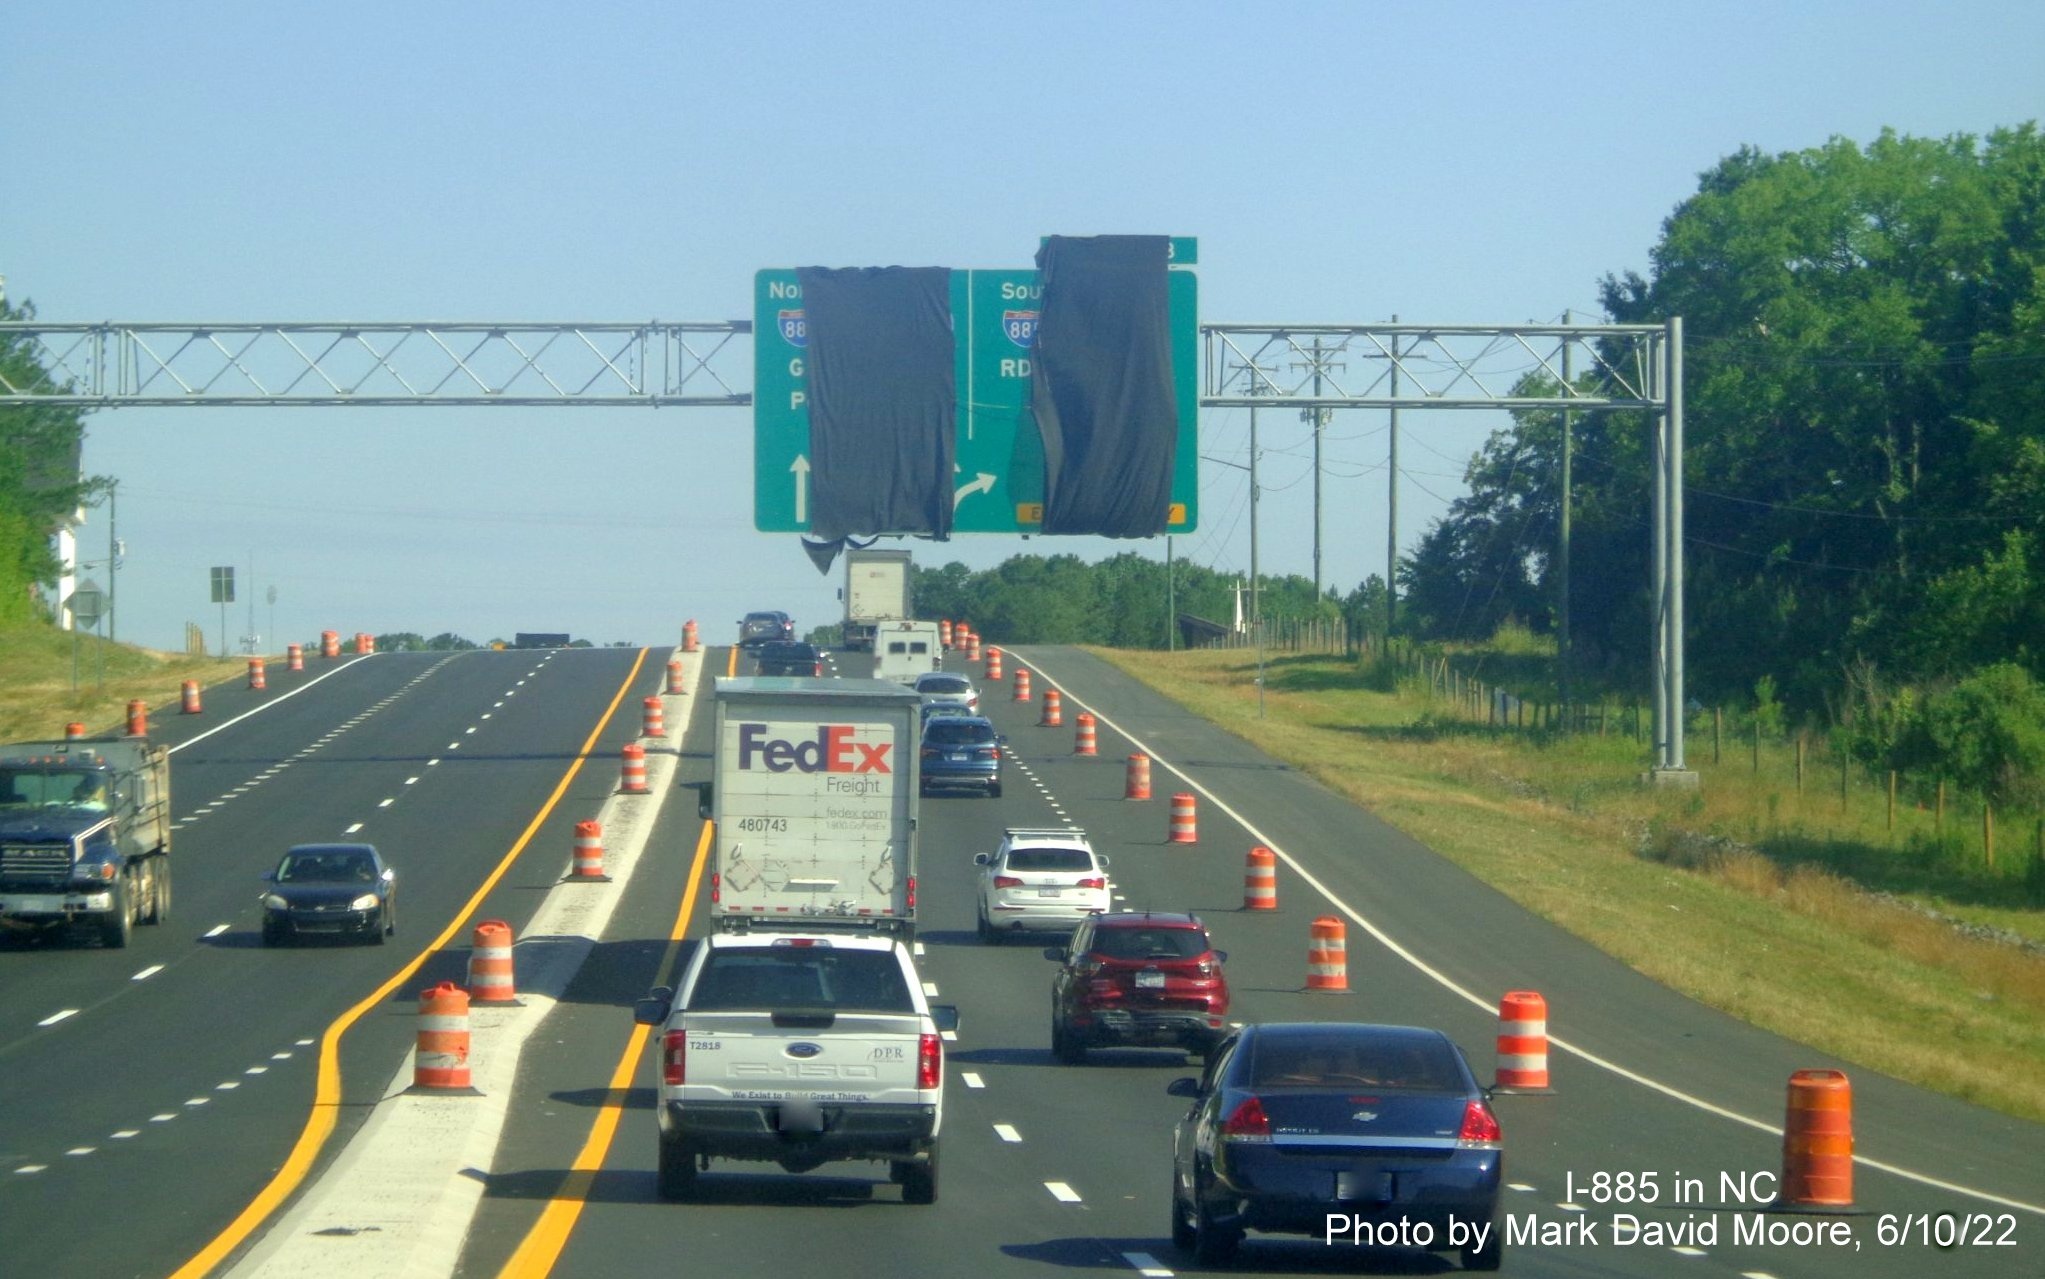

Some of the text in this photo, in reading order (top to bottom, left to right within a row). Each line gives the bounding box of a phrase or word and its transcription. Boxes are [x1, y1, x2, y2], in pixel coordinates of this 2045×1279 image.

[1000, 359, 1032, 378] RD
[738, 723, 893, 774] FedEx
[826, 776, 880, 795] Freight
[738, 818, 787, 832] 480743
[690, 1041, 721, 1051] T2818
[873, 1047, 904, 1059] DPR
[726, 1062, 878, 1081] F-150
[732, 1091, 747, 1100] We
[748, 1091, 771, 1100] Exist
[773, 1091, 783, 1100] to
[810, 1092, 836, 1101] Great
